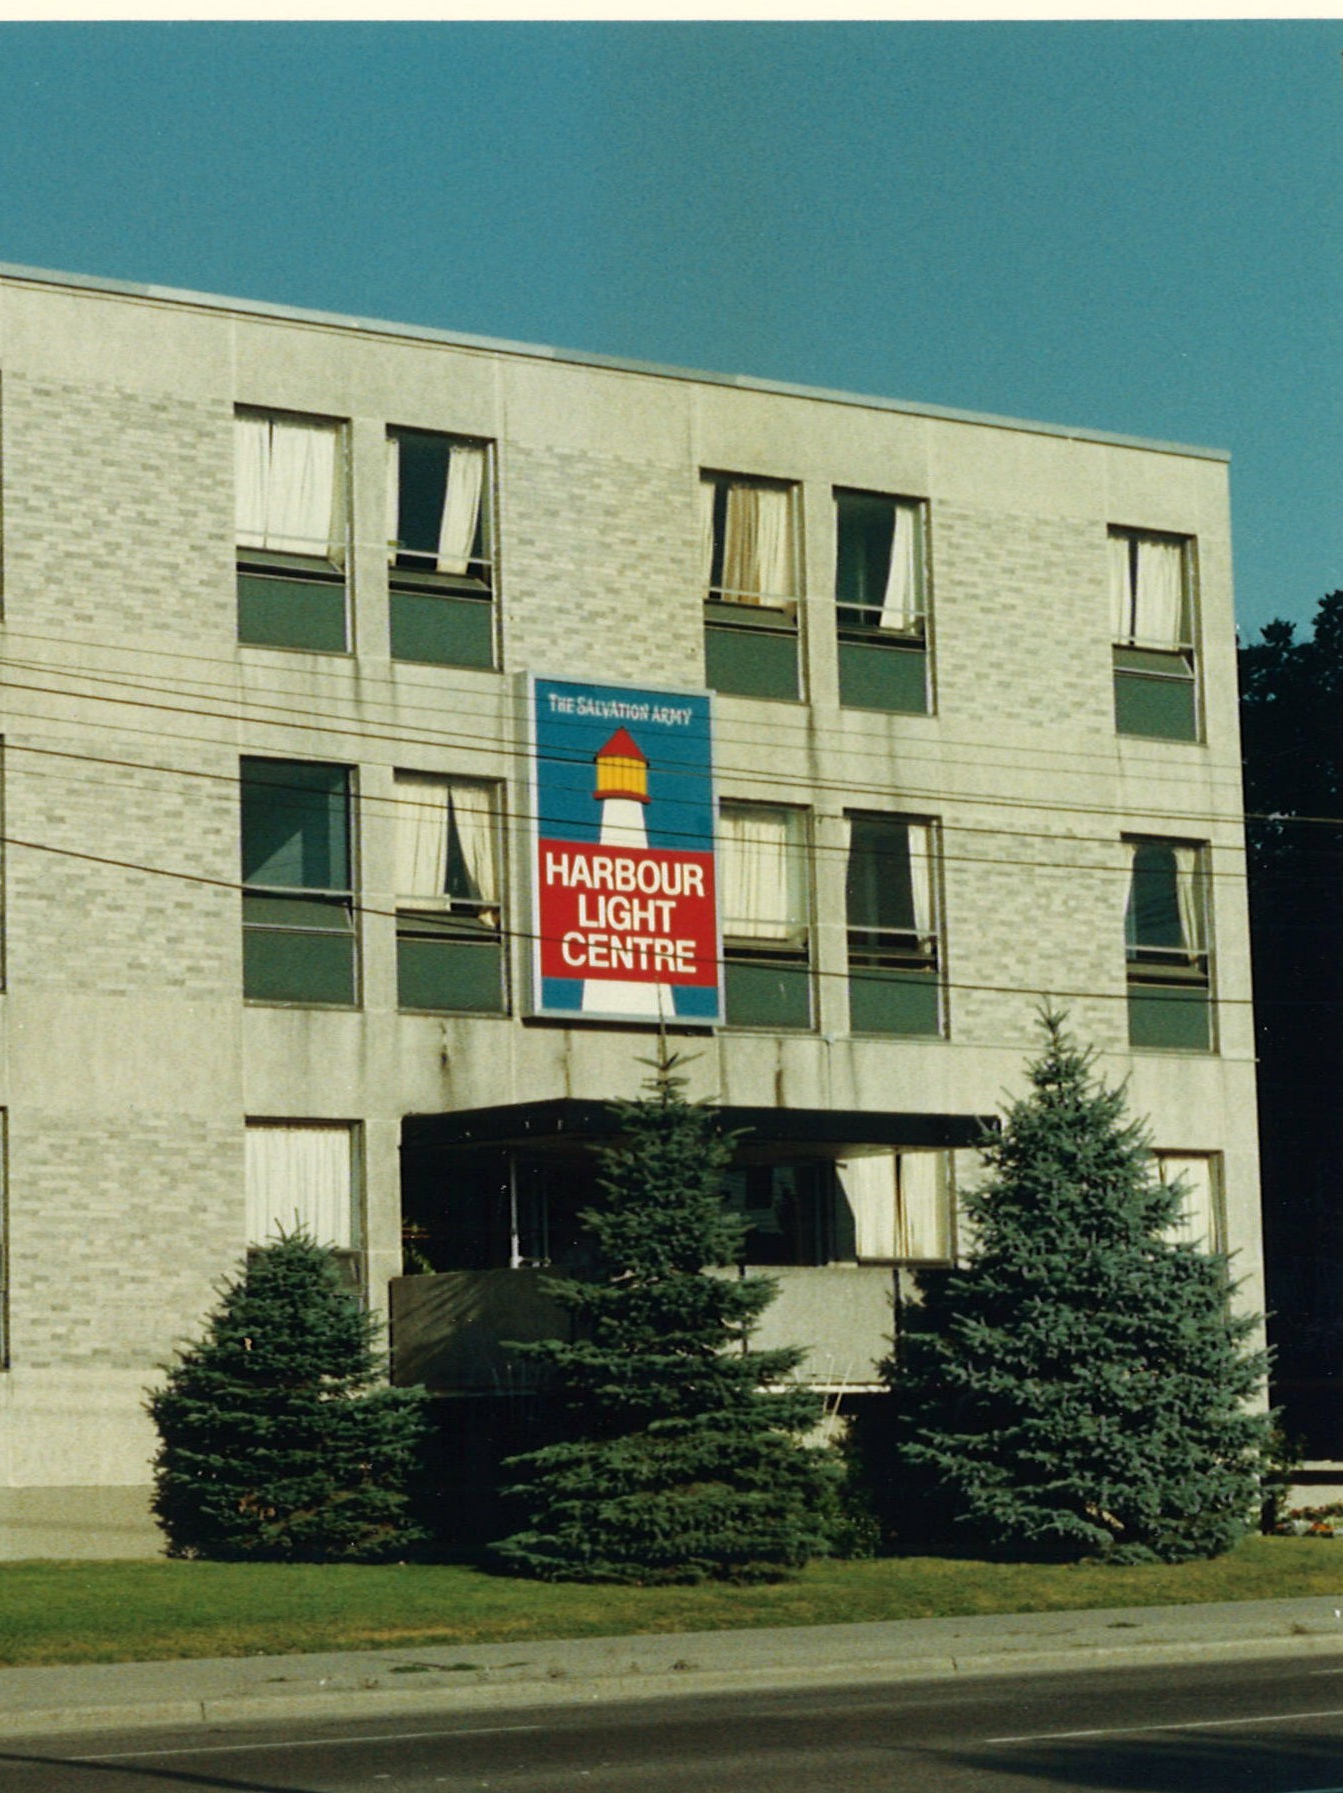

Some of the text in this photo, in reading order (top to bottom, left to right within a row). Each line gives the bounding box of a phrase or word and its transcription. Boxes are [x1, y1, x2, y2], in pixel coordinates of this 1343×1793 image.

[548, 693, 693, 726] THE SALVATION ARMY
[546, 852, 705, 897] HARBOUR
[579, 894, 676, 933] LIGHT
[562, 932, 697, 973] CENTRE
